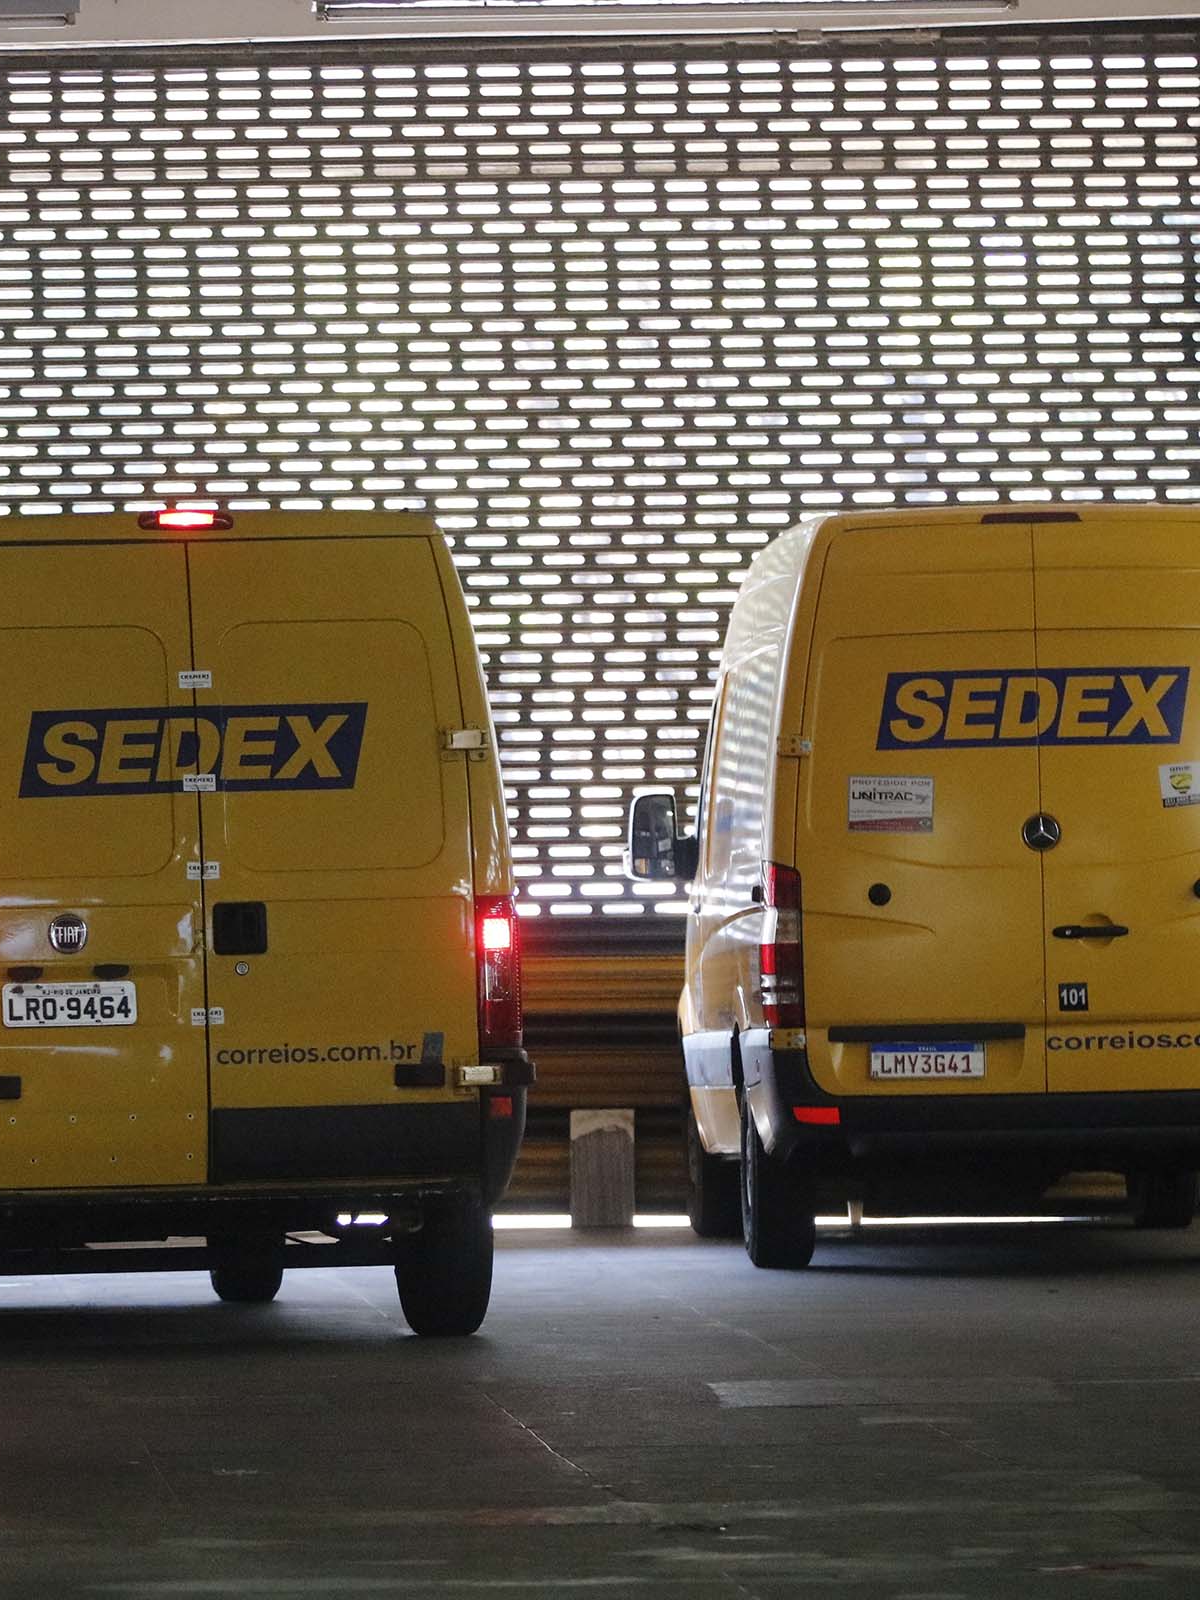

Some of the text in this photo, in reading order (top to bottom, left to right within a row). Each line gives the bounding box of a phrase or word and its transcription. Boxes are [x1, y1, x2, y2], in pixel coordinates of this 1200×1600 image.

[889, 674, 1179, 743] SEDEX
[36, 714, 349, 786] SEDEX
[55, 926, 81, 944] FIAT
[1060, 988, 1086, 1006] 101
[216, 1039, 417, 1065] correios.com.br
[880, 1054, 973, 1074] LMY3G41
